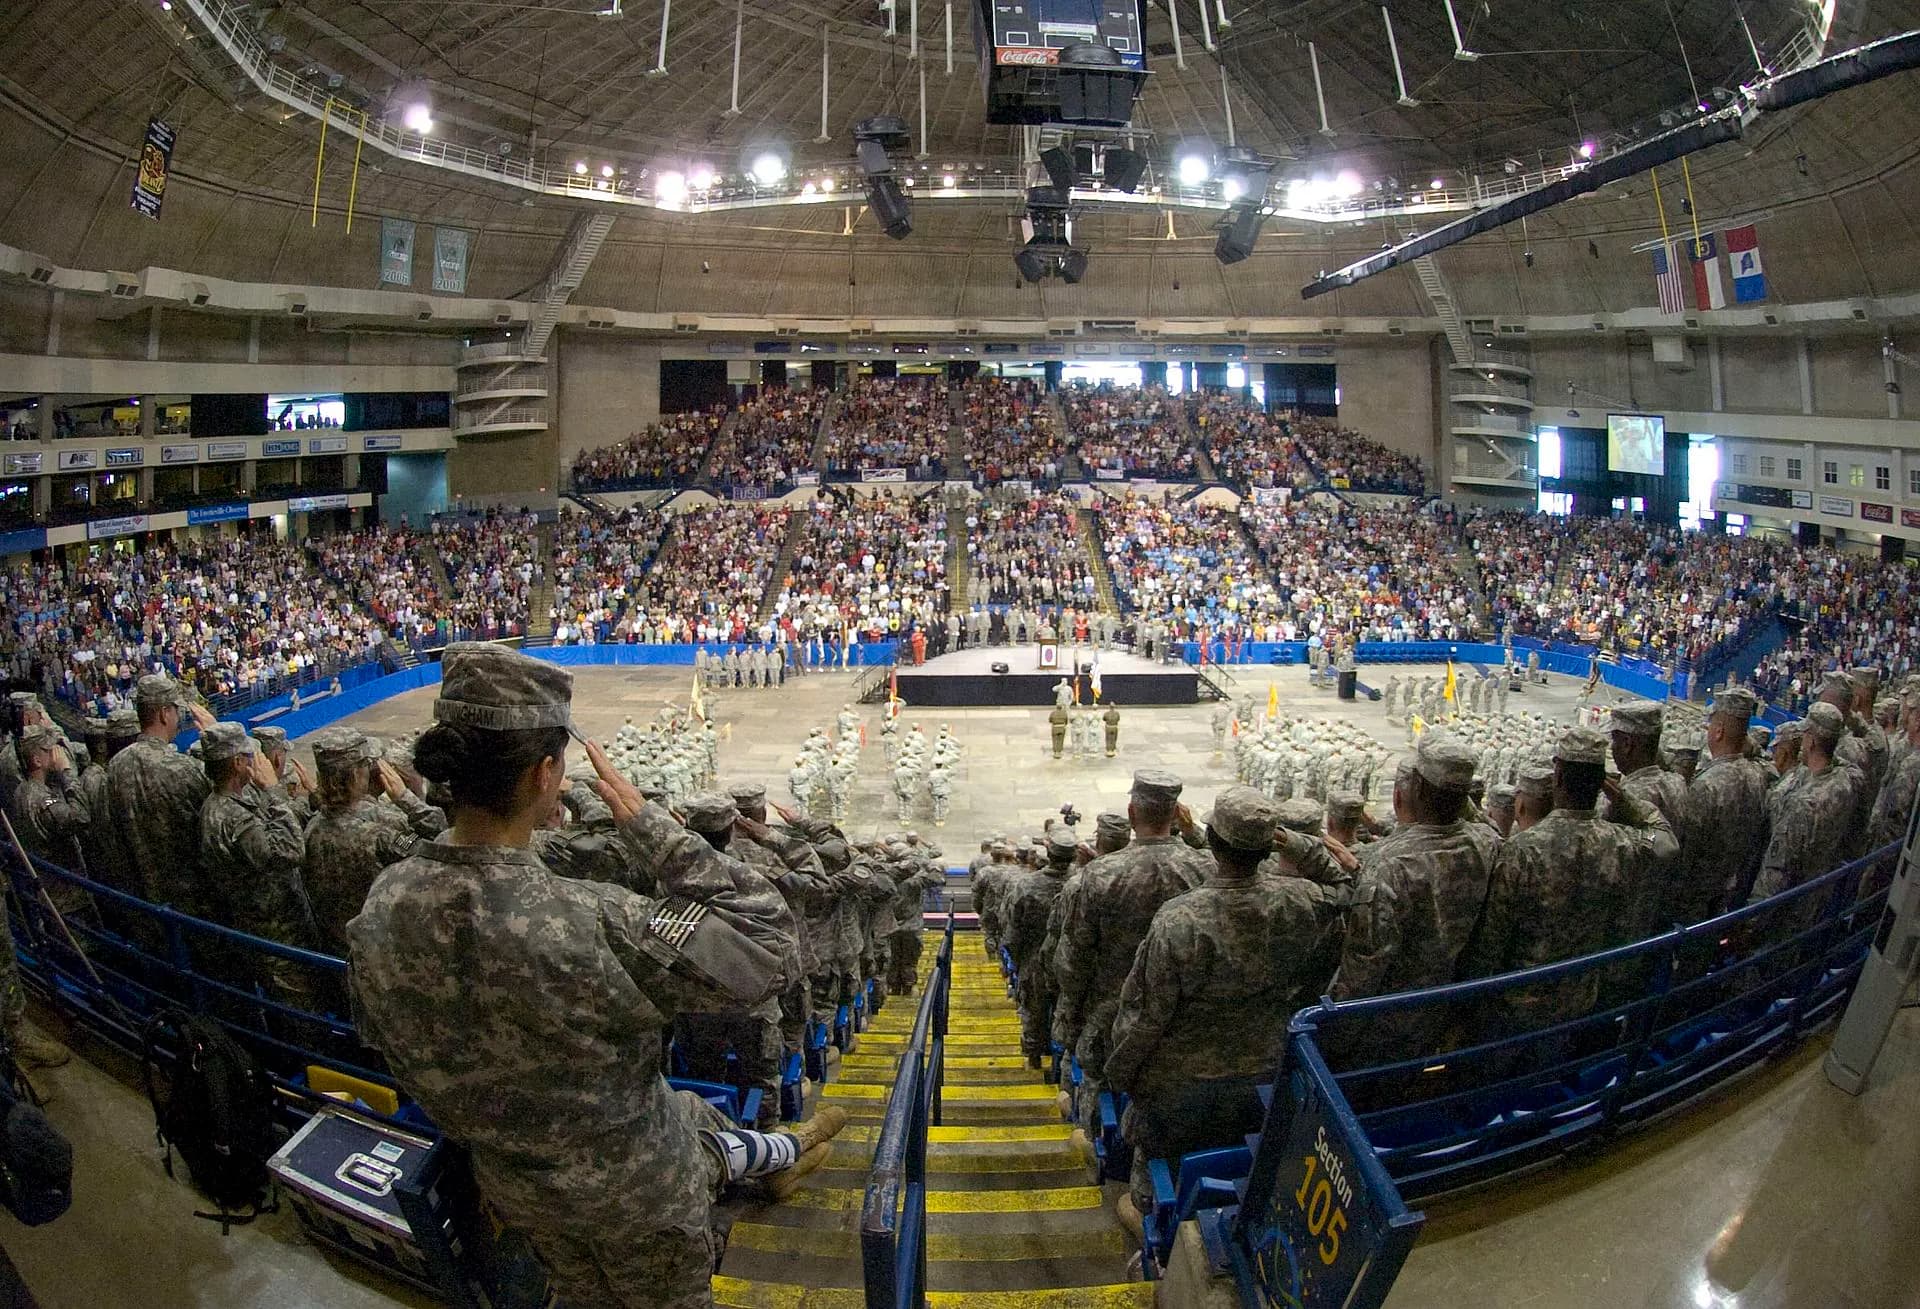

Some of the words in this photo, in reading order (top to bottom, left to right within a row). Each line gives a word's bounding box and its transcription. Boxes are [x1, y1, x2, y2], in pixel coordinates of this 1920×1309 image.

[741, 488, 760, 499] USO
[1314, 1126, 1353, 1209] Section
[1296, 1156, 1348, 1265] 105
